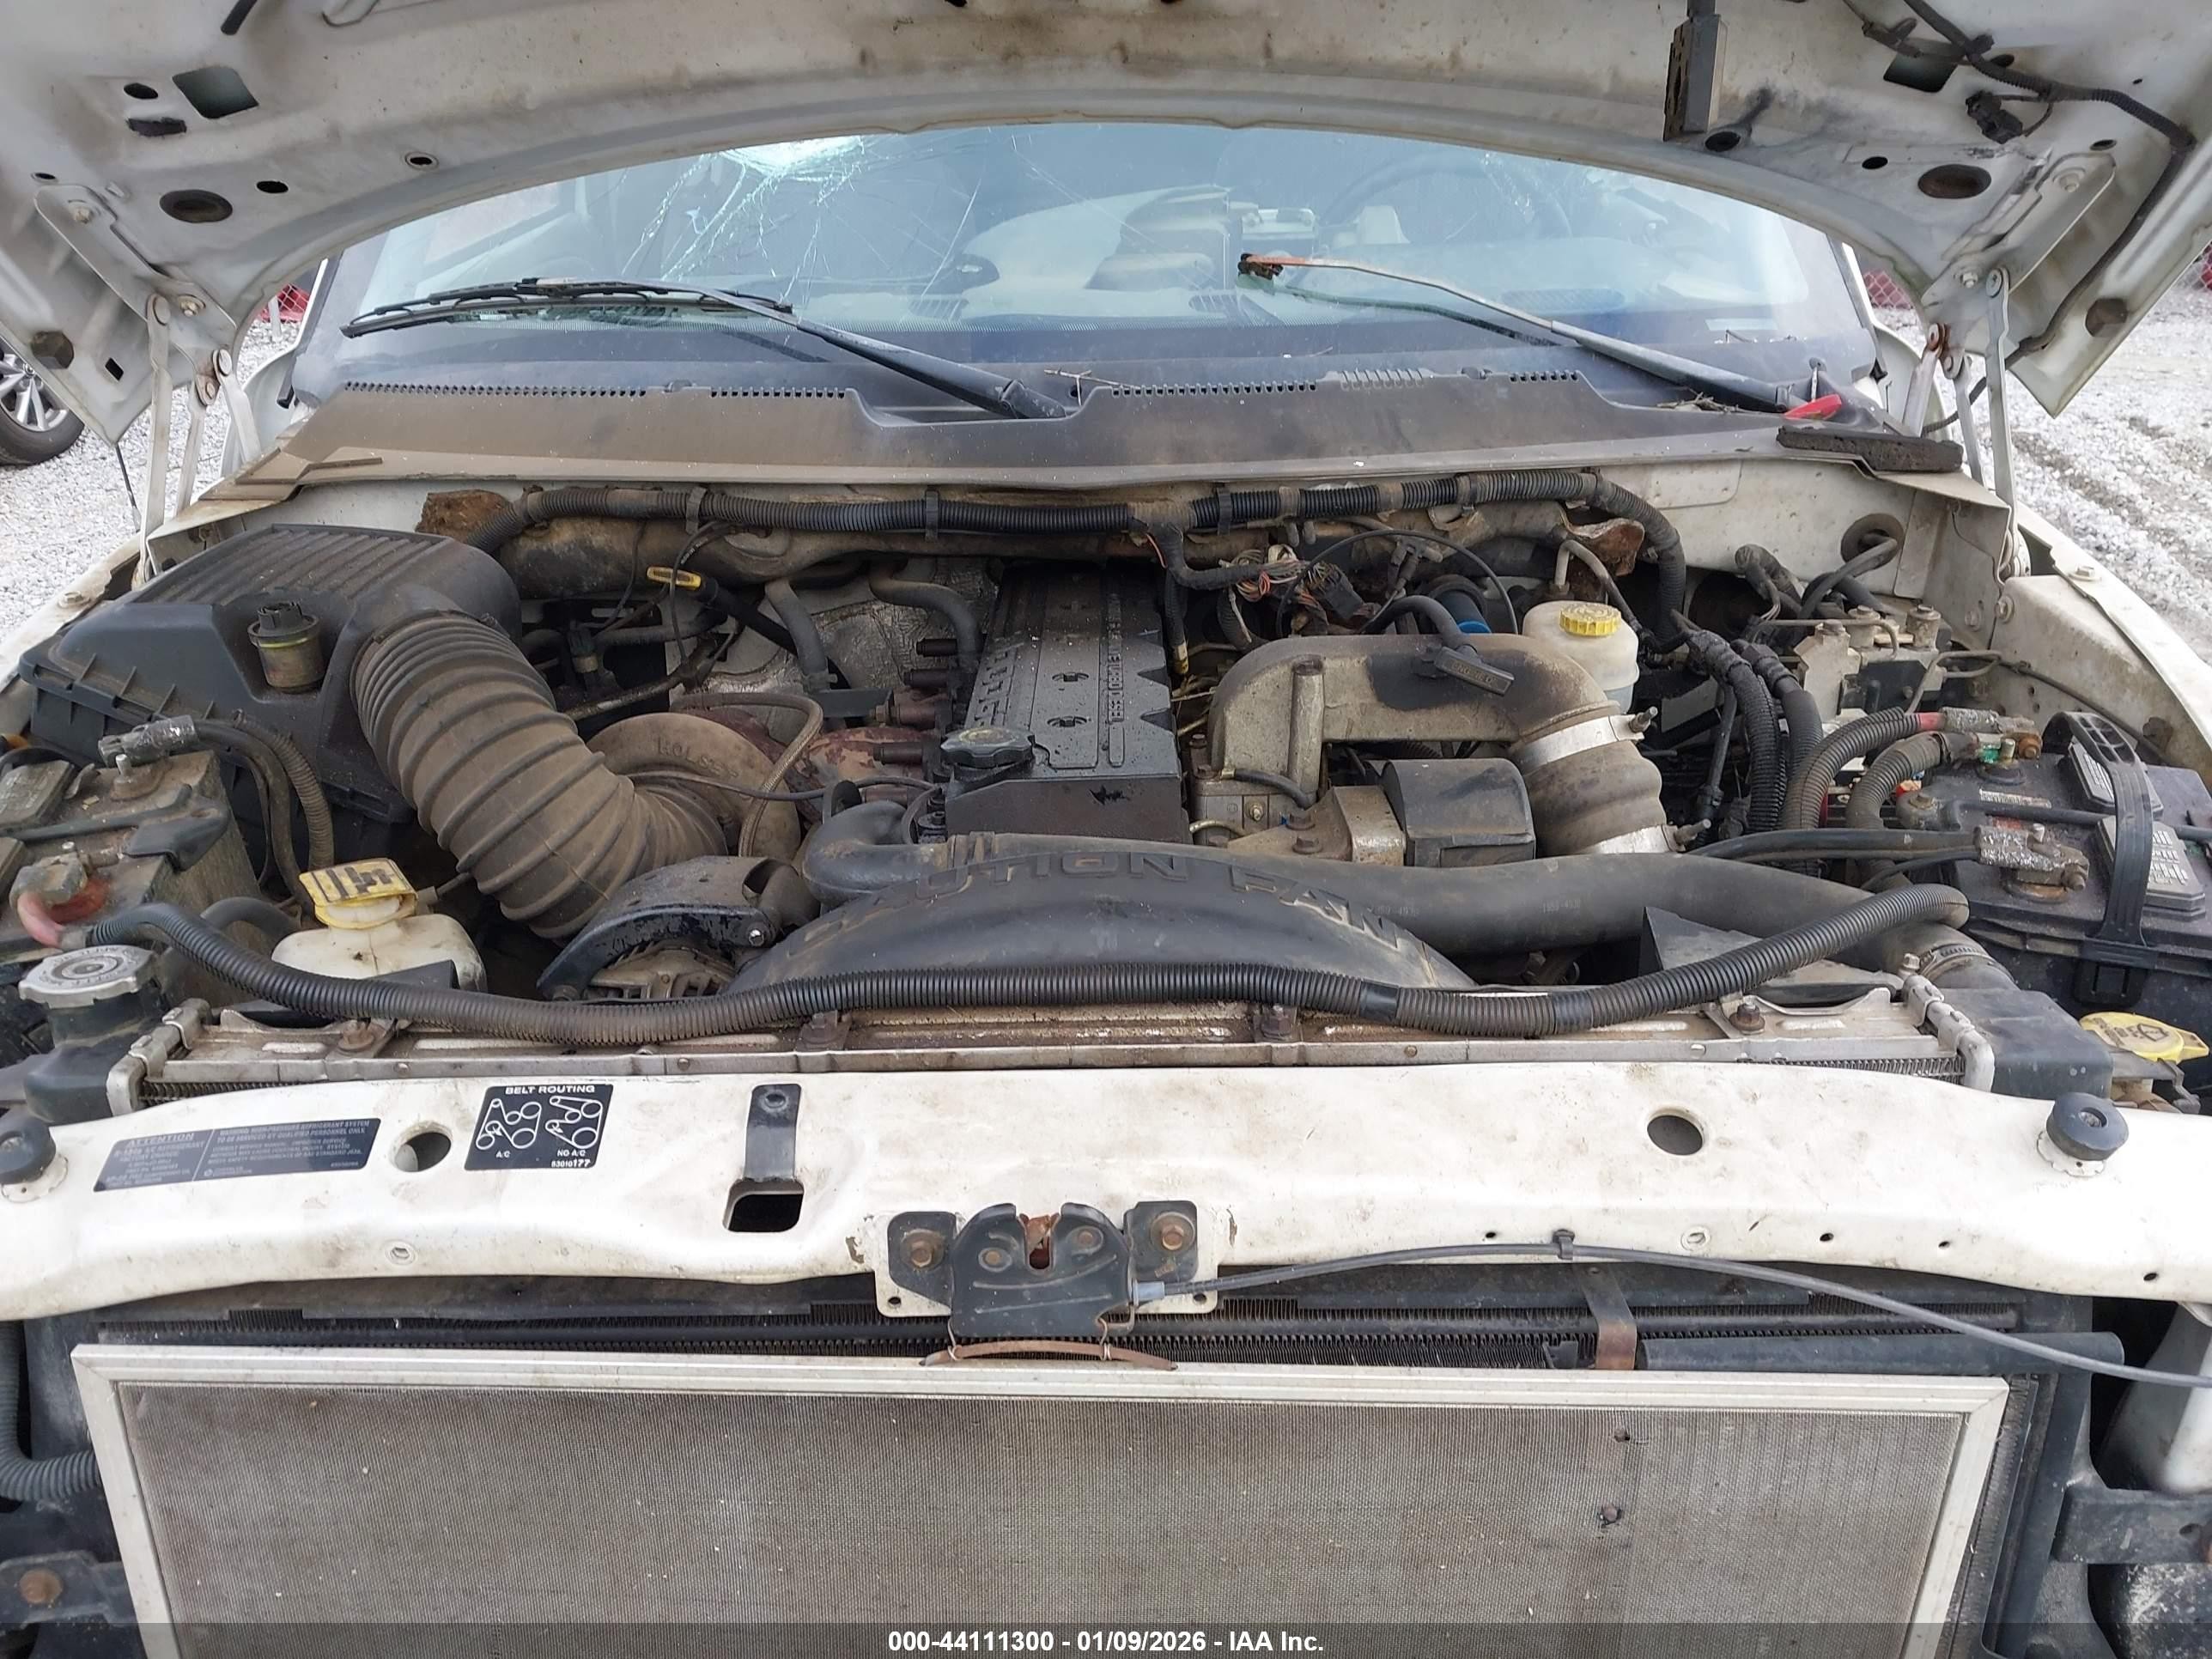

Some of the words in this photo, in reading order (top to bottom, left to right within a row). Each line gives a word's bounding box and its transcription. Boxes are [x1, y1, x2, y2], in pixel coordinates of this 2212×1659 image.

[1230, 865, 1400, 951] FAN
[505, 1085, 537, 1095] BELT
[538, 1085, 595, 1094] ROUTING
[127, 1133, 194, 1147] ATTENTION
[557, 1149, 570, 1158] NO
